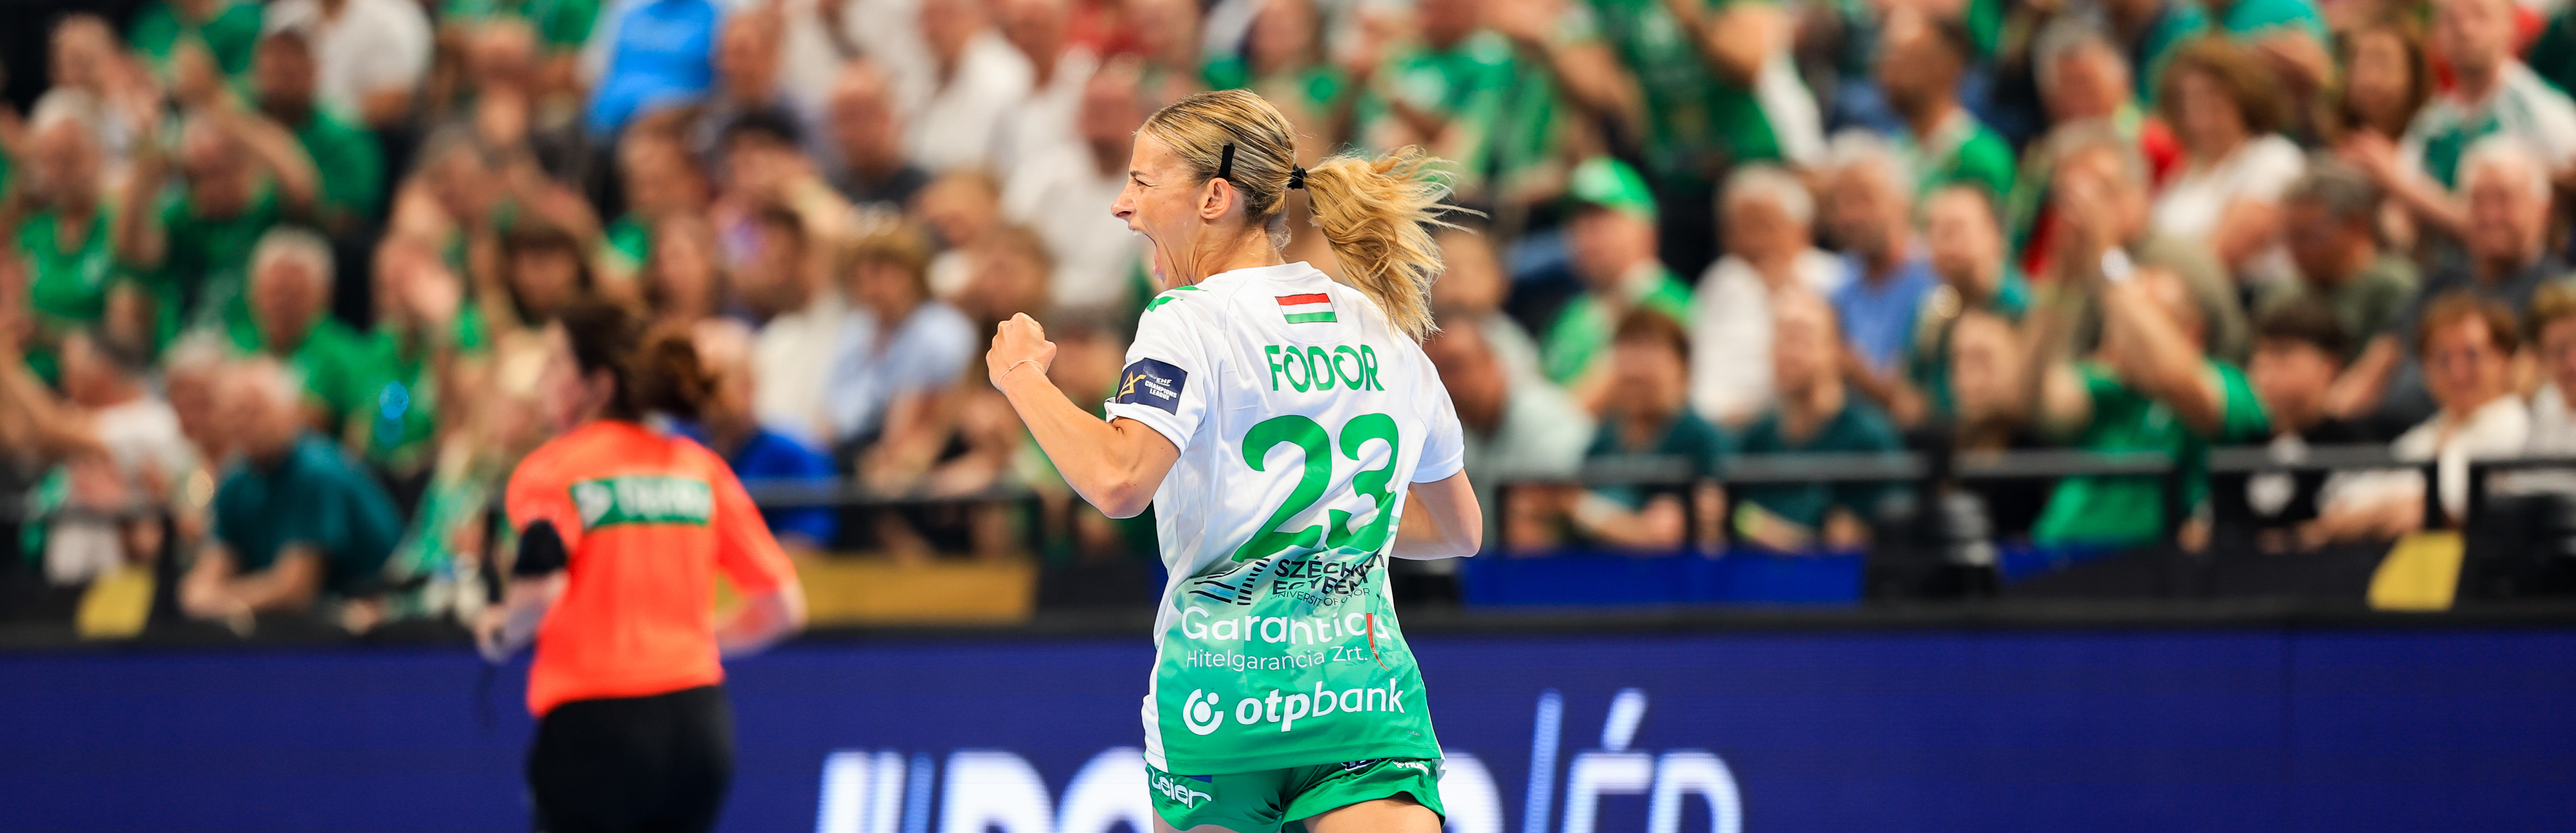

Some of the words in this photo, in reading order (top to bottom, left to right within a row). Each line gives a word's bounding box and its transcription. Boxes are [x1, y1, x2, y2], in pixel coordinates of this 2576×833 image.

[1264, 344, 1385, 393] FODOR
[1144, 380, 1177, 398] CHAMPIONS
[1149, 388, 1170, 400] LEAGUE
[1231, 413, 1399, 563] 23
[1270, 590, 1322, 607] NIVERSIT
[1323, 598, 1339, 606] OF
[1186, 649, 1325, 672] Hitelgarancia
[1330, 646, 1368, 662] Zrt.
[1235, 678, 1405, 732] otpbank
[1149, 767, 1212, 809] Leier
